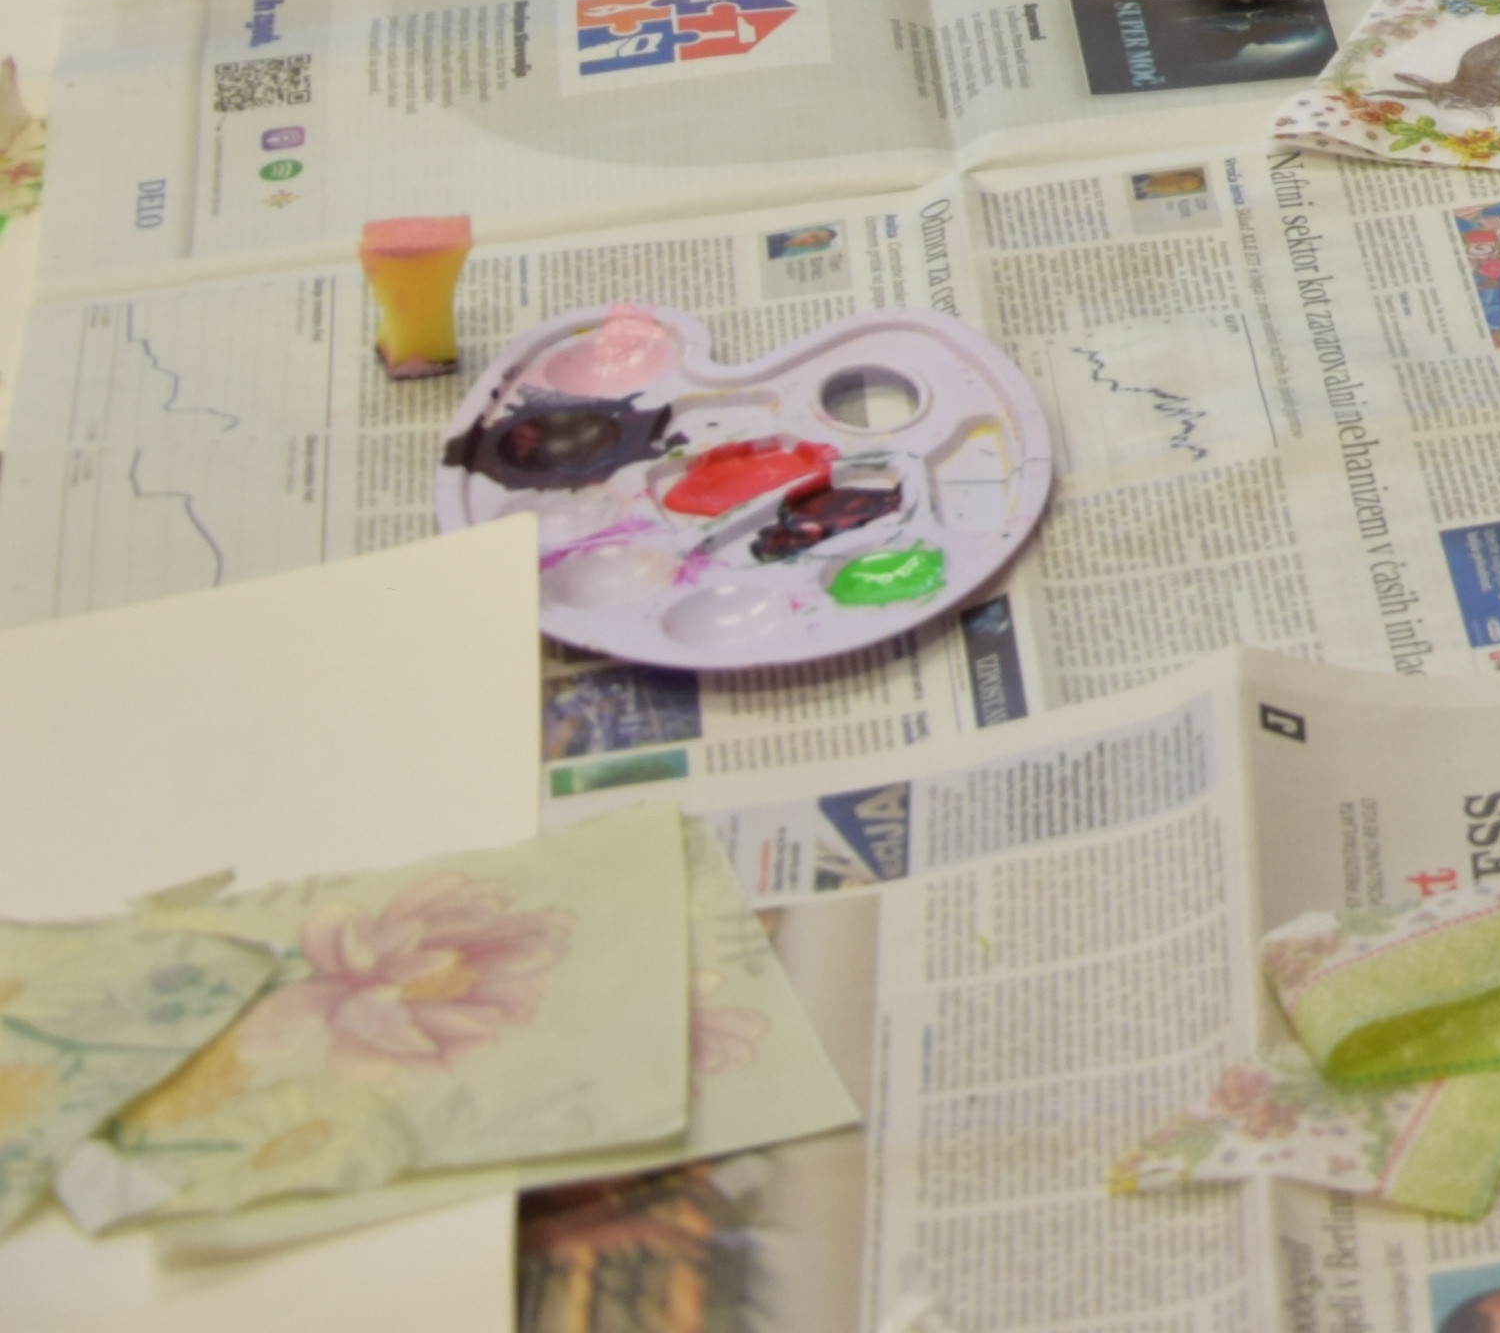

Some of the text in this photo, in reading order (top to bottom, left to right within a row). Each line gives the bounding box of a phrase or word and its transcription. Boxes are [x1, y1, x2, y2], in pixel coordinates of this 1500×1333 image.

[1113, 1, 1150, 49] SUPER
[134, 178, 168, 229] DELO
[1266, 153, 1314, 209] Naftni
[919, 198, 953, 263] Odmor
[1280, 215, 1323, 273] sektor
[929, 263, 954, 287] za
[1296, 275, 1334, 308] kot
[1304, 311, 1368, 408] zavarovalni
[1367, 541, 1395, 557] v
[1369, 560, 1421, 615] časih
